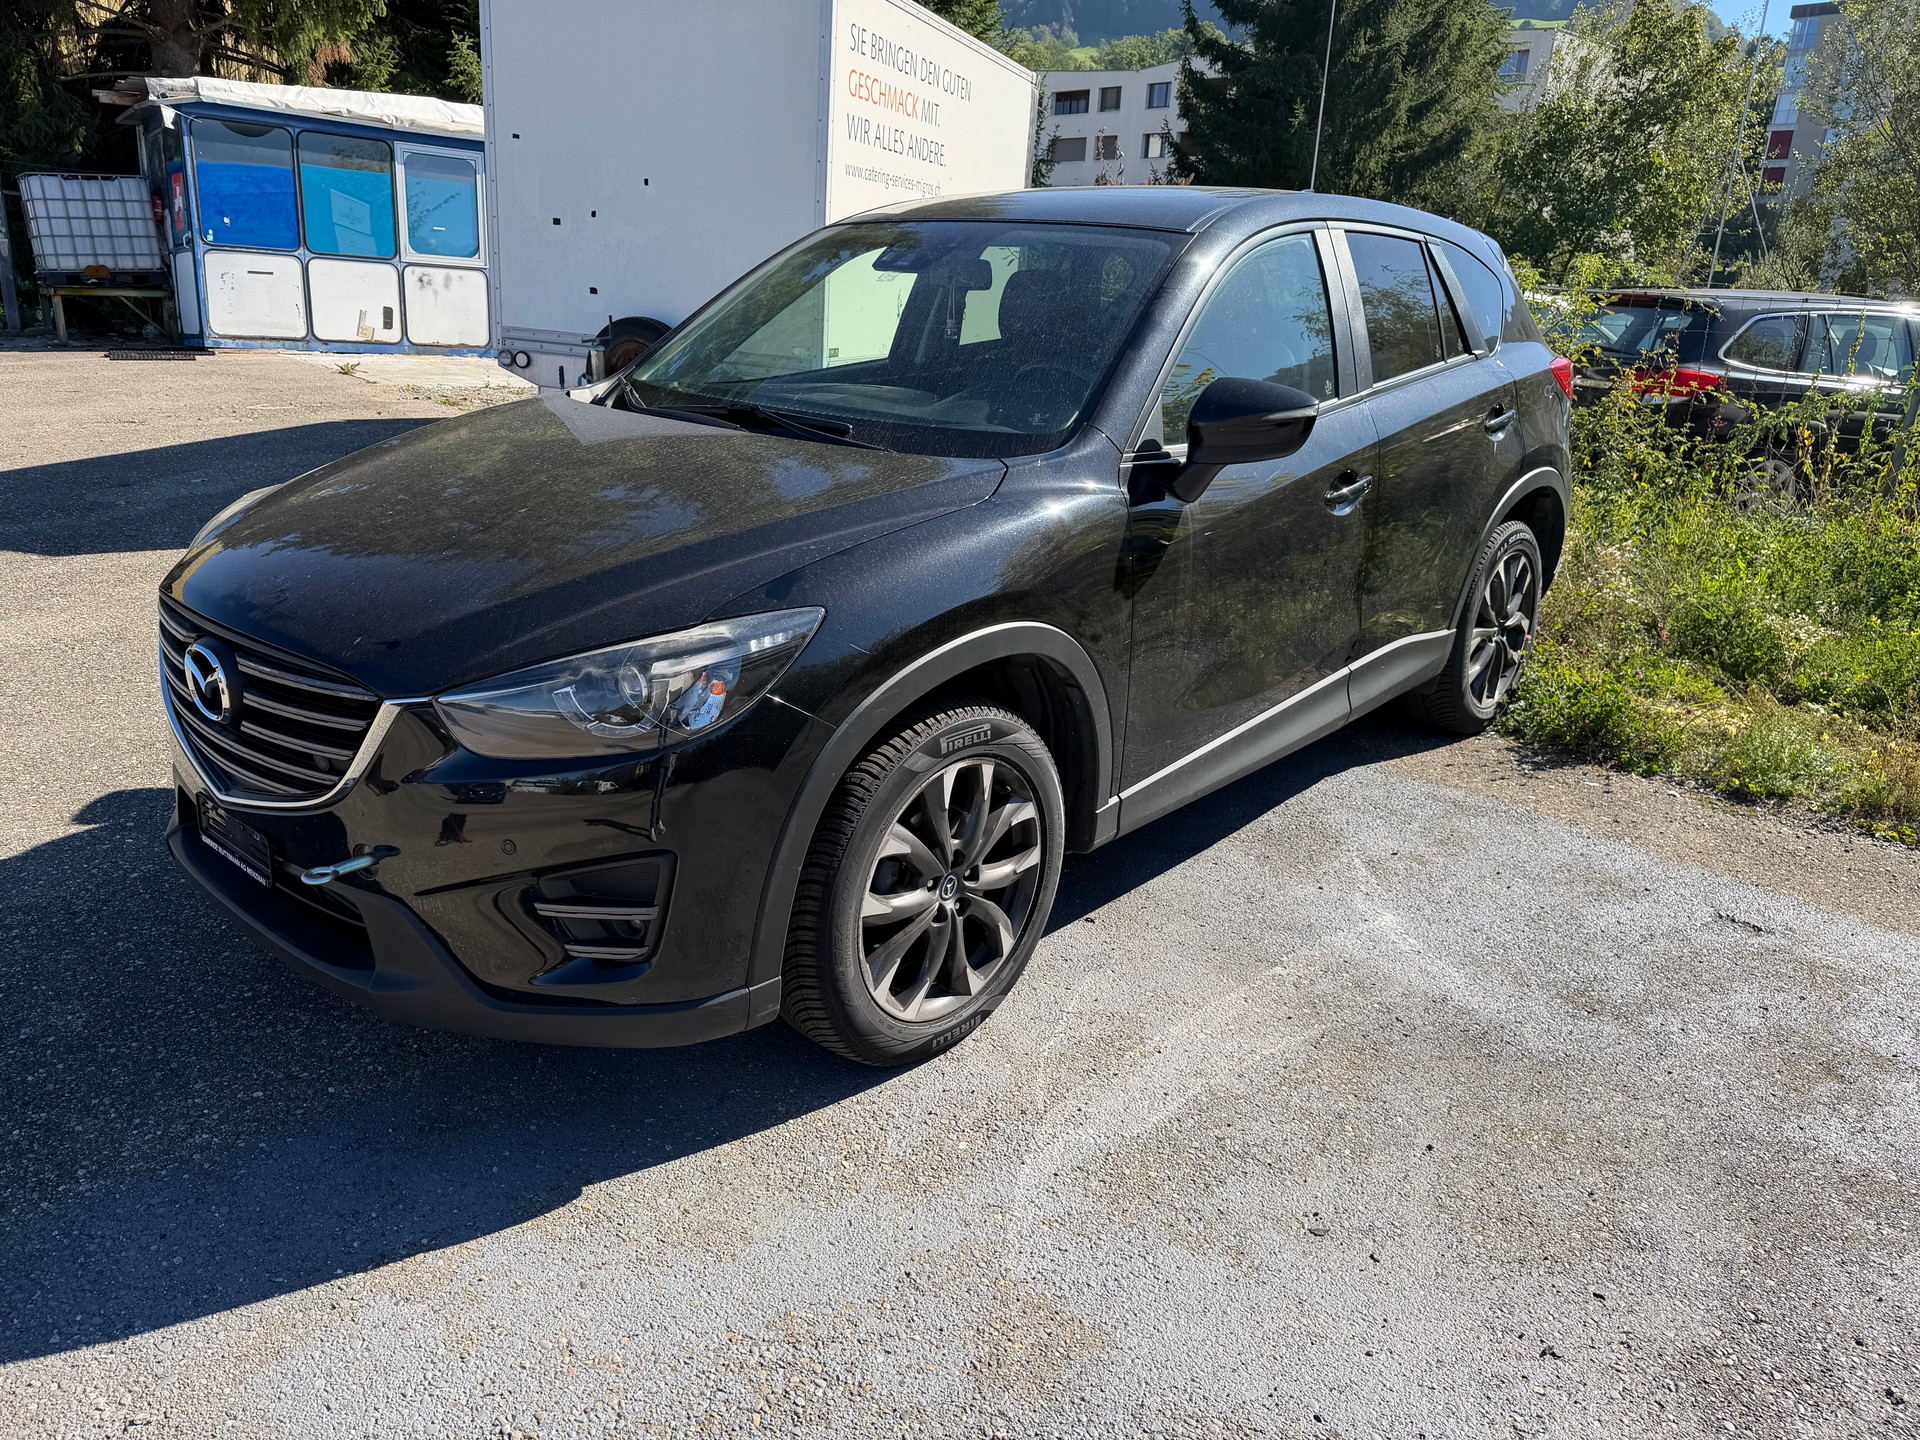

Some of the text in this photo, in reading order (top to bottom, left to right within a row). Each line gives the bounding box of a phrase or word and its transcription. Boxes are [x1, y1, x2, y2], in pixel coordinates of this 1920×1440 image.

[850, 23, 972, 103] SIE BRINGEN DEN GUTEN
[848, 69, 940, 128] GESCHMACK MIT.
[846, 112, 946, 167] WIR ALLES ANDERE.
[939, 723, 992, 754] PIRELLI
